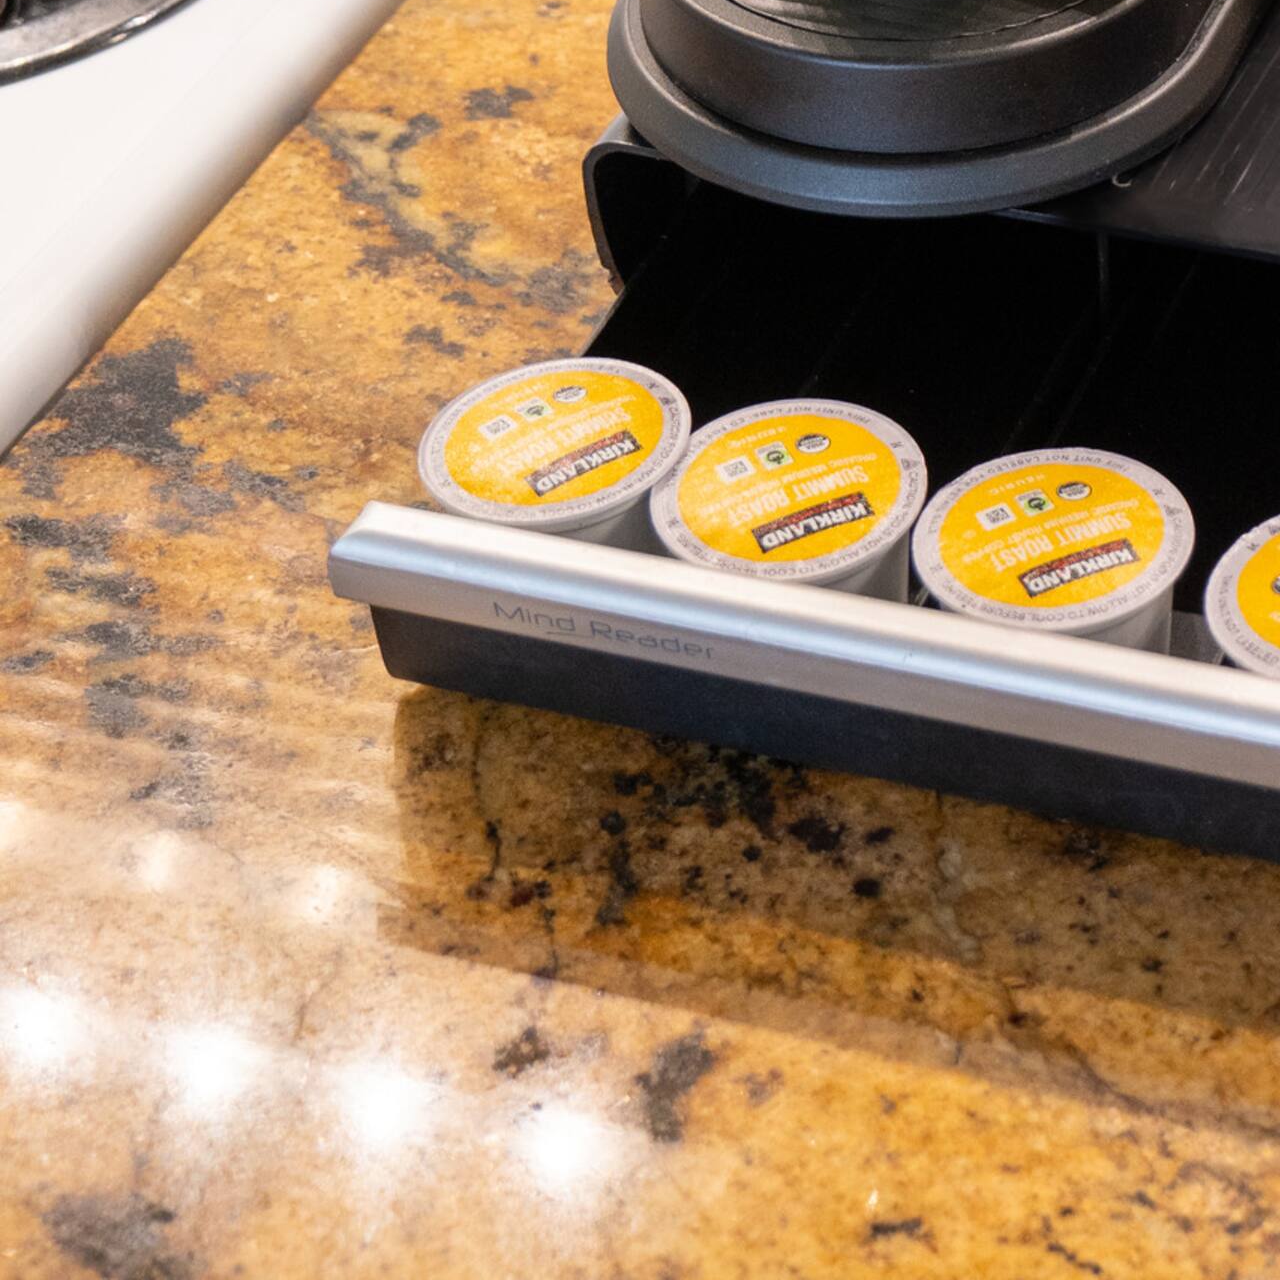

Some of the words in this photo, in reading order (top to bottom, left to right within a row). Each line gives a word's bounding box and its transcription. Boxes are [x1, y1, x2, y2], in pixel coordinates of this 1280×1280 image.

[534, 438, 635, 492] KIRKLAND
[792, 463, 869, 500] SUMMIT
[726, 489, 789, 527] ROAST
[759, 500, 866, 548] KIRKLAND
[1054, 510, 1132, 546] SUMMIT
[989, 534, 1052, 572] ROAST
[1025, 547, 1133, 593] KIRKLAND
[493, 601, 576, 634] Mind
[589, 620, 714, 660] Reader
